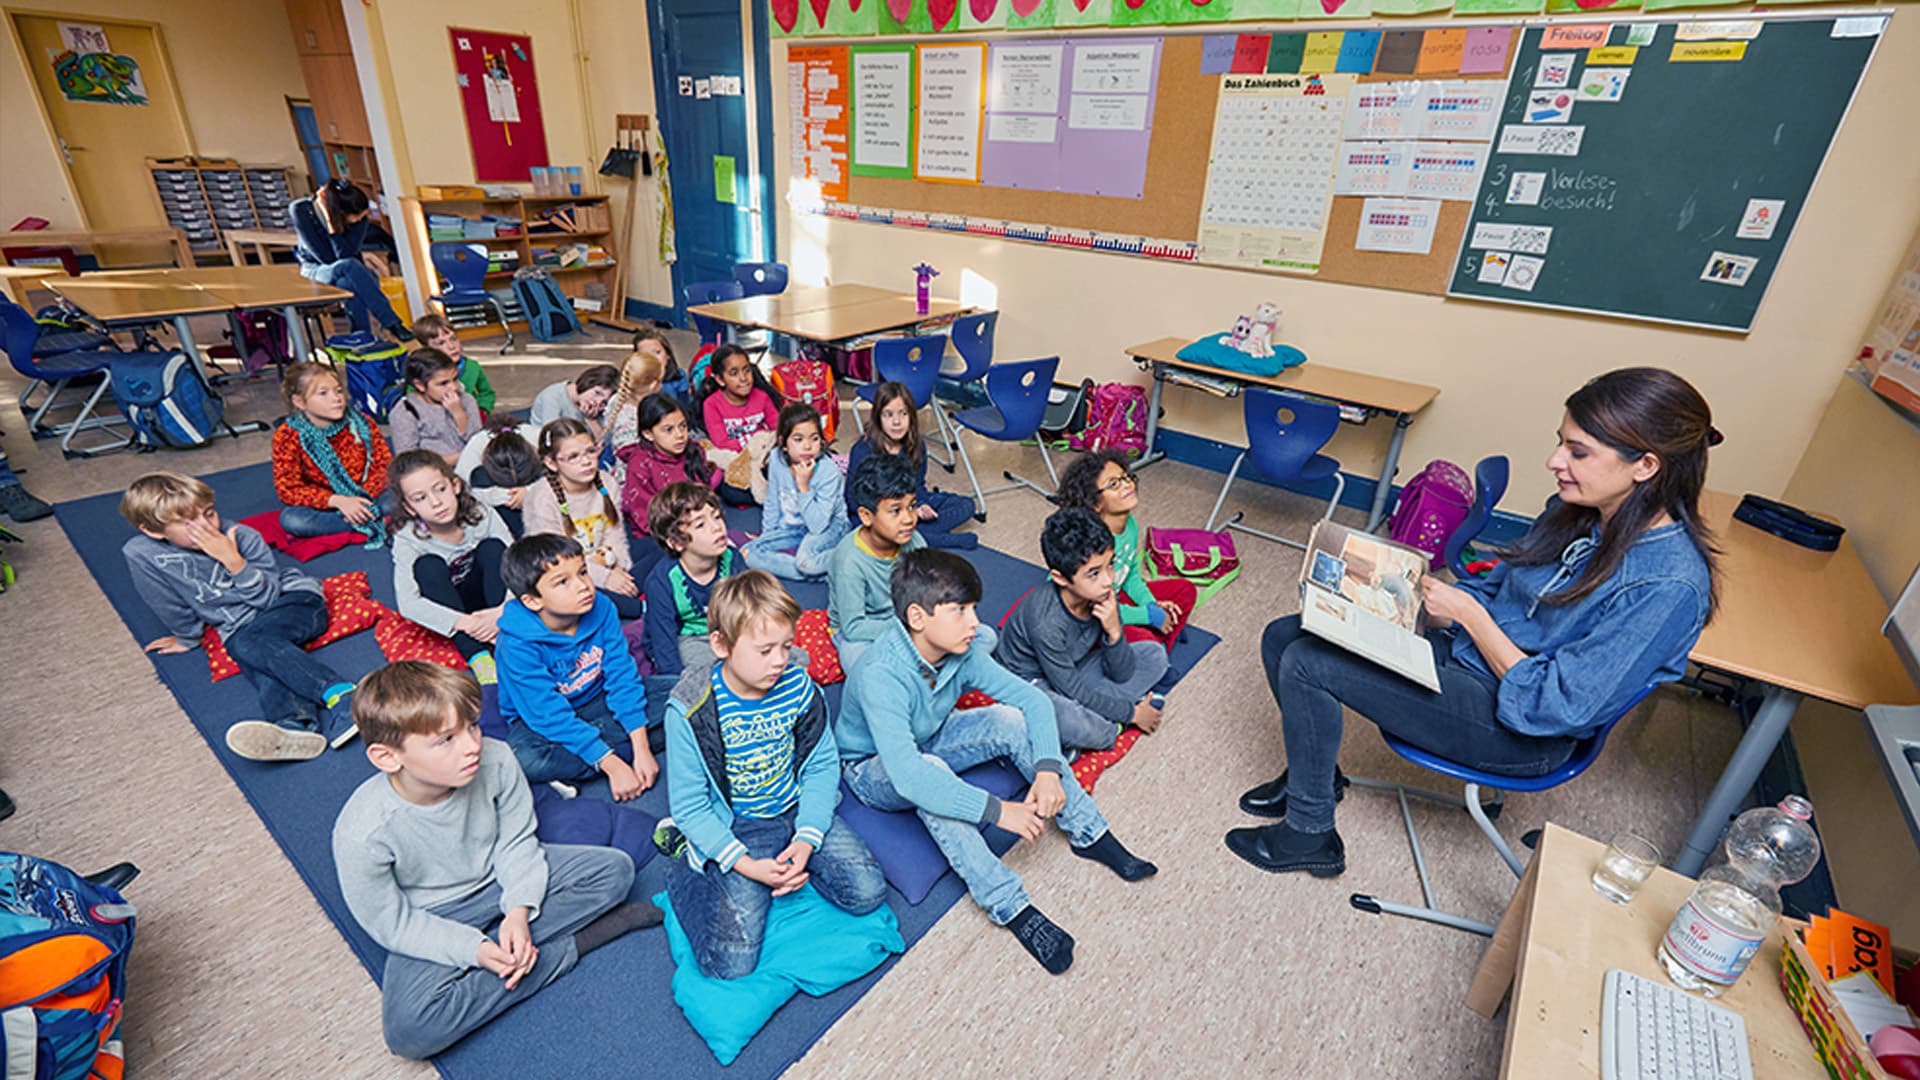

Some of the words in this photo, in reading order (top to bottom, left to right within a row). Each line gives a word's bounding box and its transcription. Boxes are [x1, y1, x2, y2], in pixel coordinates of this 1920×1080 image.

[1551, 28, 1604, 41] Freitag
[1470, 44, 1502, 57] rosa
[1224, 79, 1242, 89] Das
[1244, 78, 1301, 88] Zahlenbuch
[1551, 168, 1617, 190] Vorlese-
